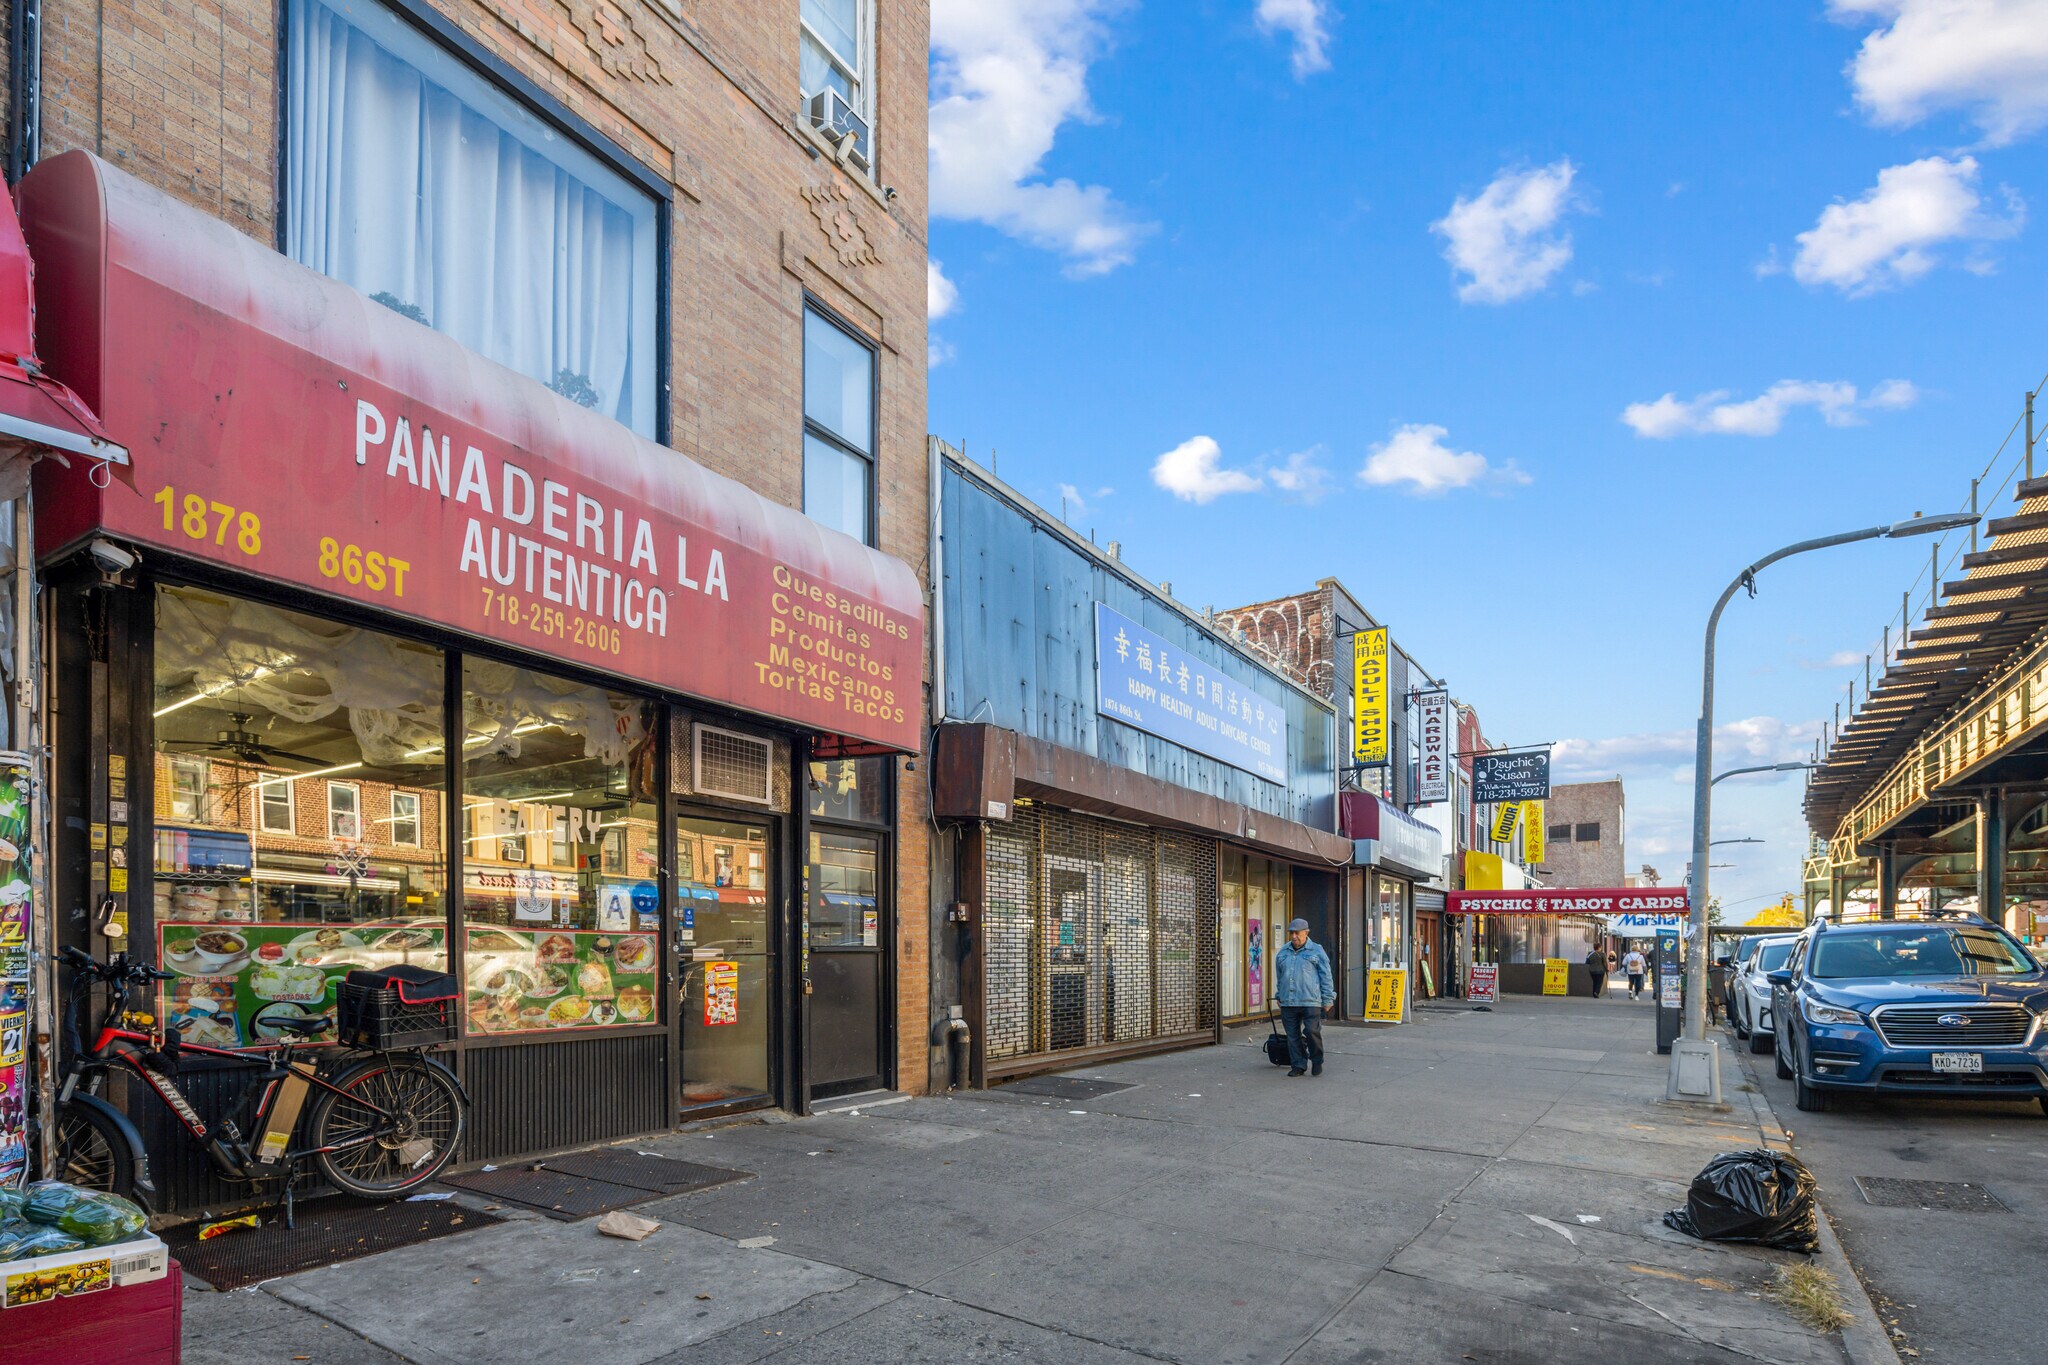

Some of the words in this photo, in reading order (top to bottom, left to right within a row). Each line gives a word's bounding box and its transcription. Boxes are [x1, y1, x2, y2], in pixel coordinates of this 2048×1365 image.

[154, 485, 262, 556] 1878
[356, 398, 659, 577] PANADERIA
[677, 534, 729, 602] LA
[318, 536, 410, 598] 86ST
[459, 517, 668, 638] AUTENTICA
[481, 586, 622, 656] 718-259-2606
[771, 592, 872, 650] Cemitas
[772, 564, 909, 641] Quesadillas
[769, 617, 894, 682] Productos
[754, 661, 836, 703] Tortas
[841, 690, 906, 725] Tacos
[769, 643, 896, 707] Mexicanos
[1113, 626, 1279, 736] 幸福長者日間活動中心
[1361, 659, 1380, 703] ADULT
[1128, 677, 1157, 704] HAPPY
[1160, 691, 1194, 722] HEALTHY
[1196, 709, 1218, 732] ADULT
[1220, 722, 1248, 746] DAYCARE
[1251, 735, 1272, 757] CENTER
[1361, 708, 1380, 746] SHOP
[1425, 707, 1441, 781] HARDWARE
[1487, 757, 1534, 773] Psychic
[1421, 781, 1445, 790] ELECTRICAL
[1422, 789, 1445, 797] PLUMBING
[1477, 787, 1546, 800] 718-234-5927
[1494, 769, 1531, 781] Susan
[493, 797, 602, 845] BAKERY
[1497, 807, 1518, 840] LIQUOR
[606, 894, 625, 920] A
[1460, 899, 1533, 910] PSYCHIC
[1550, 898, 1613, 909] TAROT
[1618, 896, 1685, 909] CARDS
[3, 1027, 23, 1057] 21
[1957, 1057, 1980, 1068] 7236
[77, 1265, 107, 1279] OX
